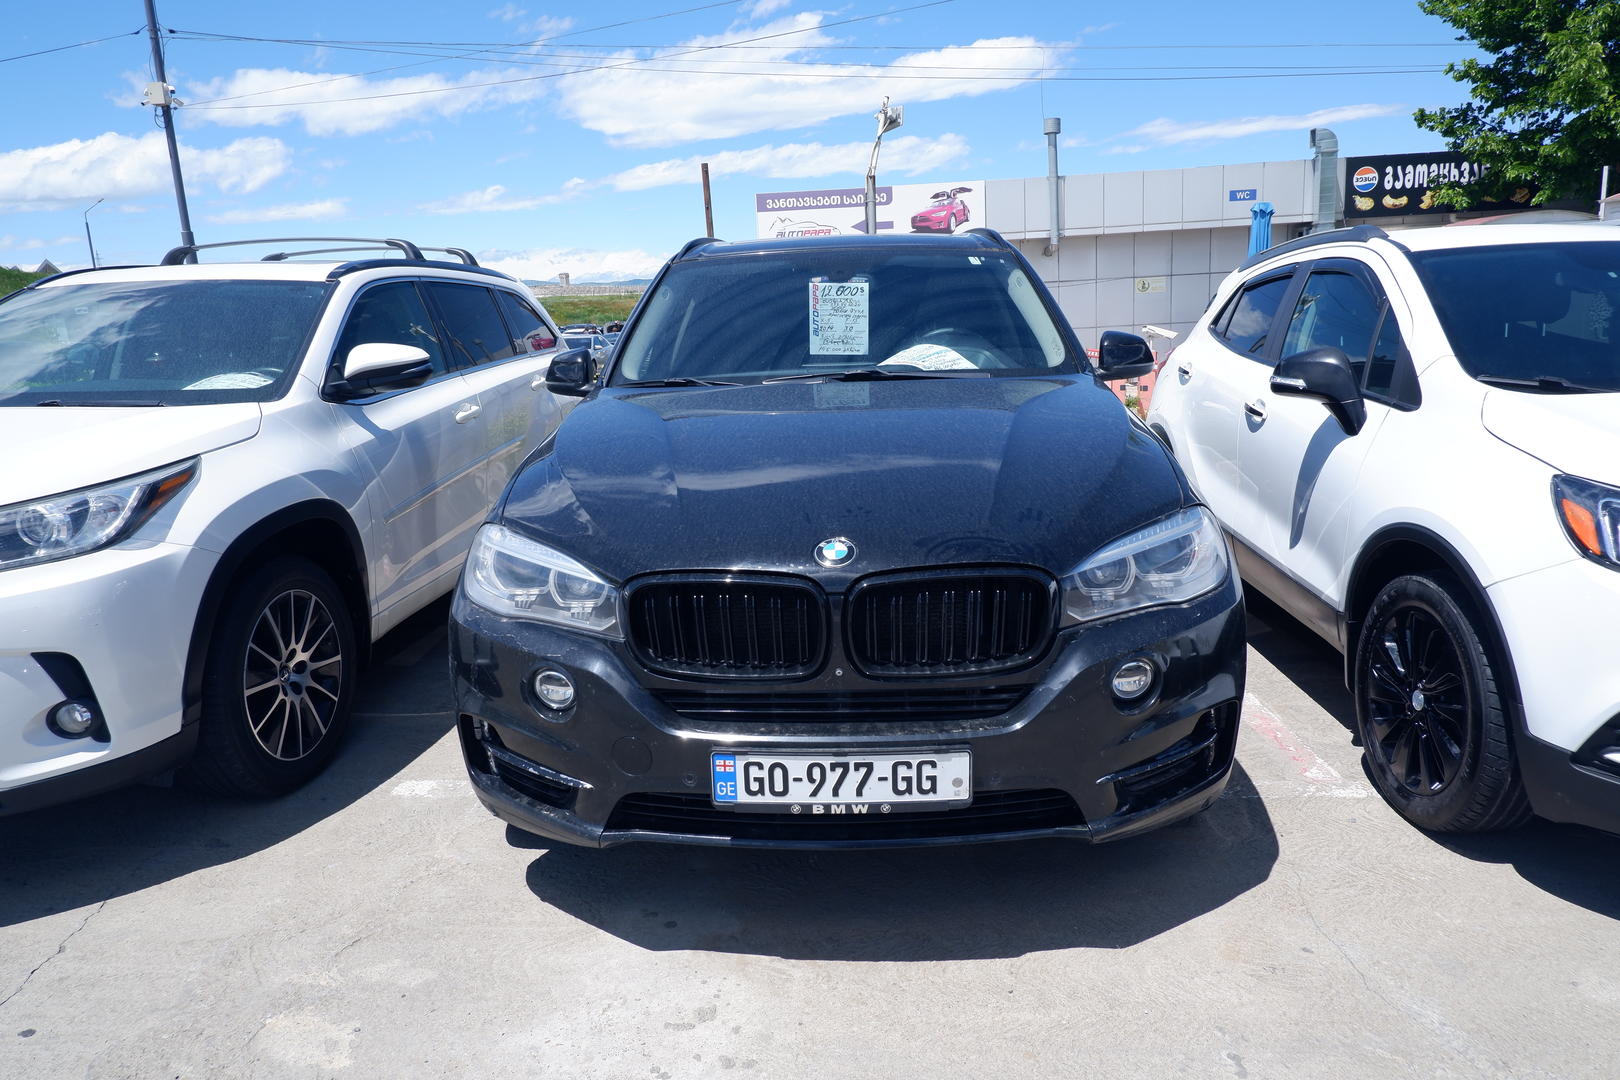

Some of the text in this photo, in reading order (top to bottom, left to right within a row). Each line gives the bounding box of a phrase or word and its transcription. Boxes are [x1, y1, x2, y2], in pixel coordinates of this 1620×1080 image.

[766, 195, 841, 209] ვანთავსებთ
[1236, 191, 1250, 199] WC
[743, 760, 938, 798] GO-977-GG
[717, 781, 736, 796] GE
[812, 804, 869, 815] BMW
